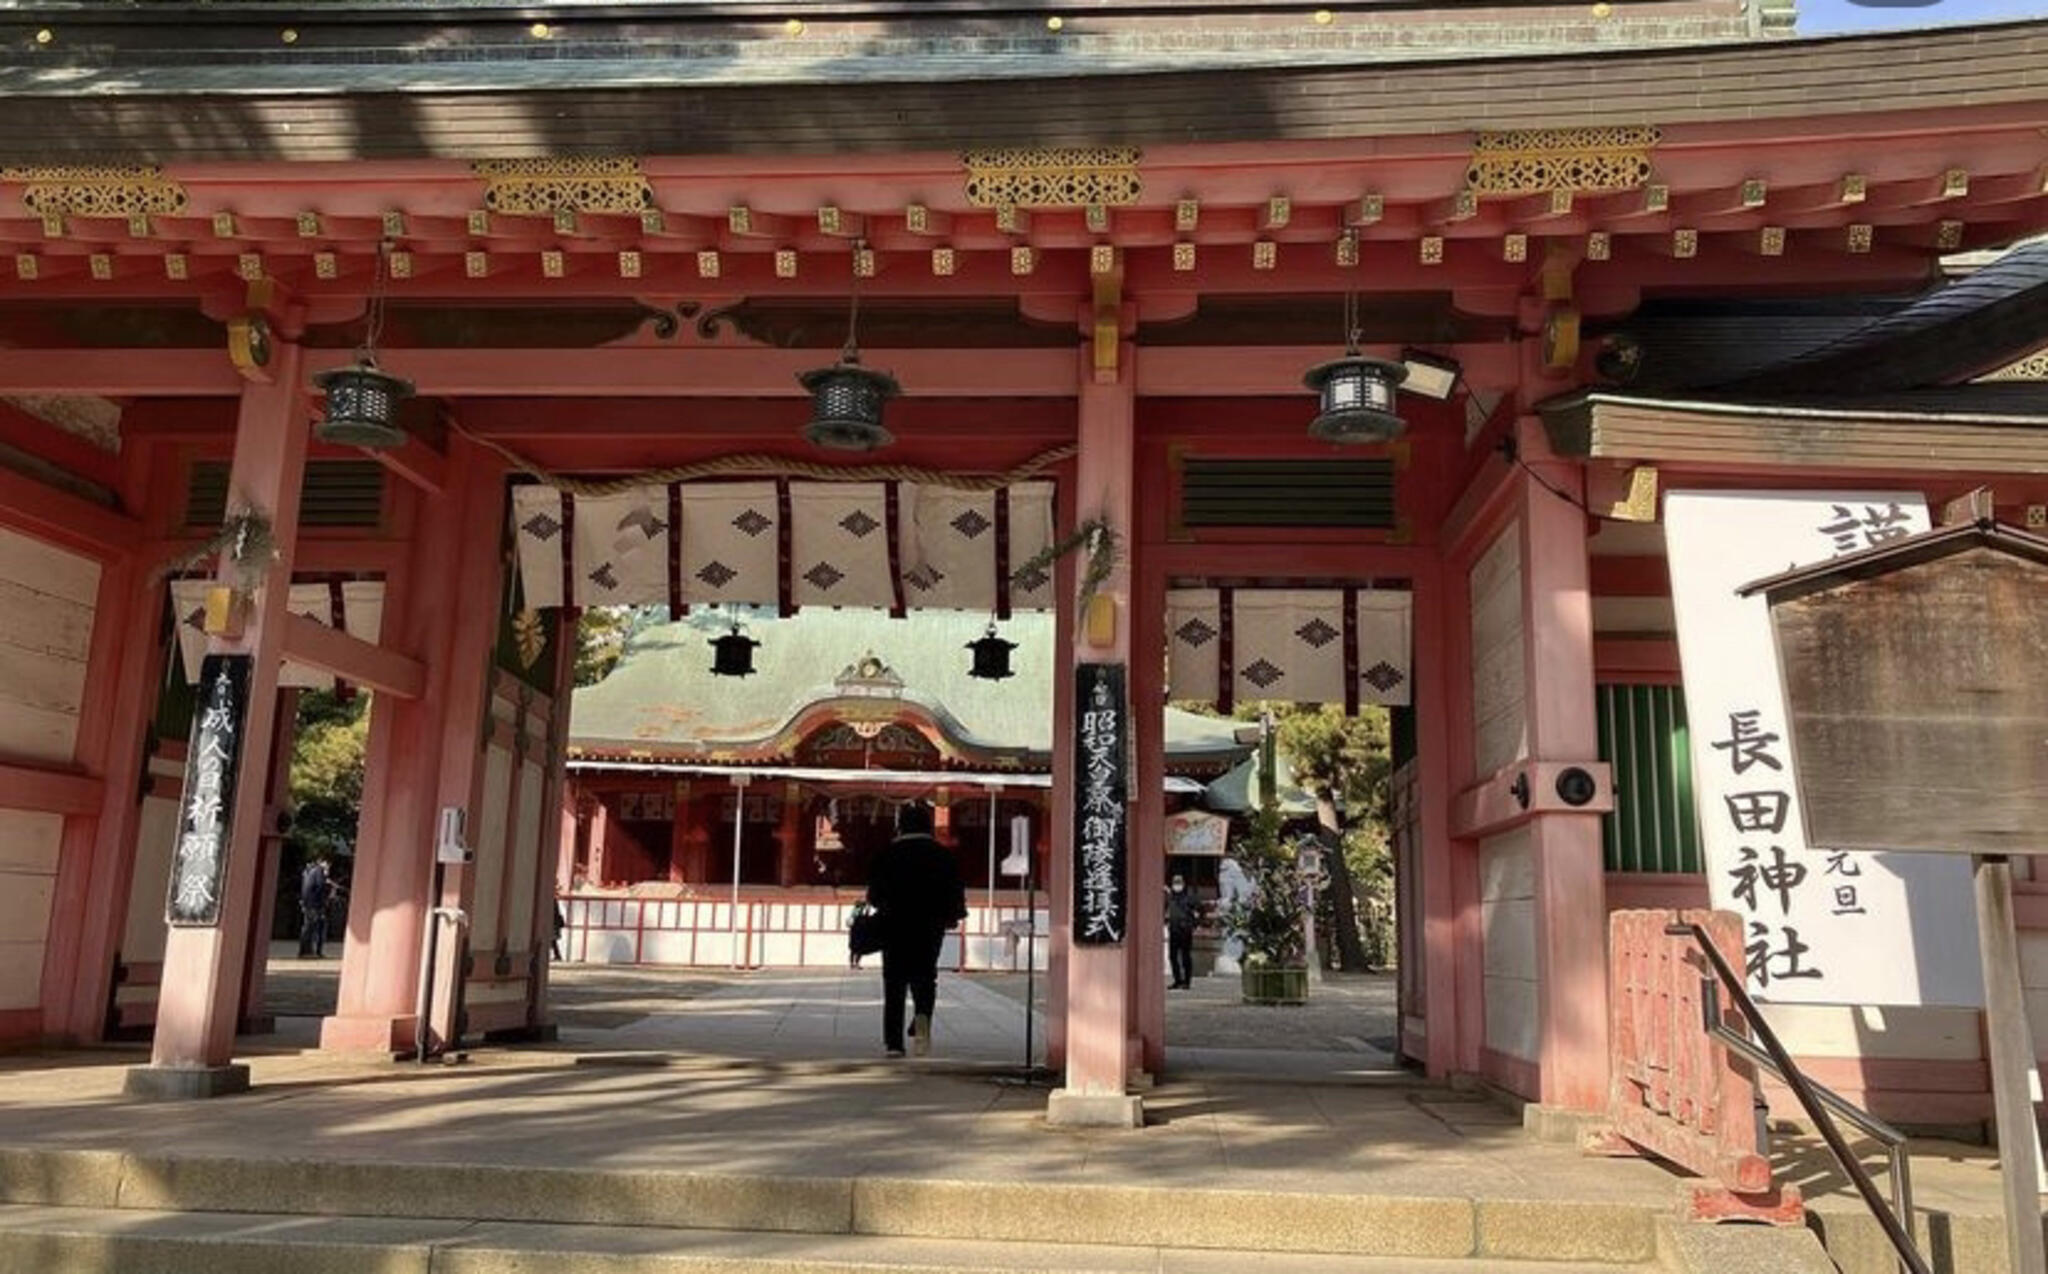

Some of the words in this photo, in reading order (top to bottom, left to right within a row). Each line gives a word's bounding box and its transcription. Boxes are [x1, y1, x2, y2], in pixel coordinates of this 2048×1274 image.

[1711, 710, 1824, 989] 長田神社
[1825, 849, 1868, 916] 元旦
